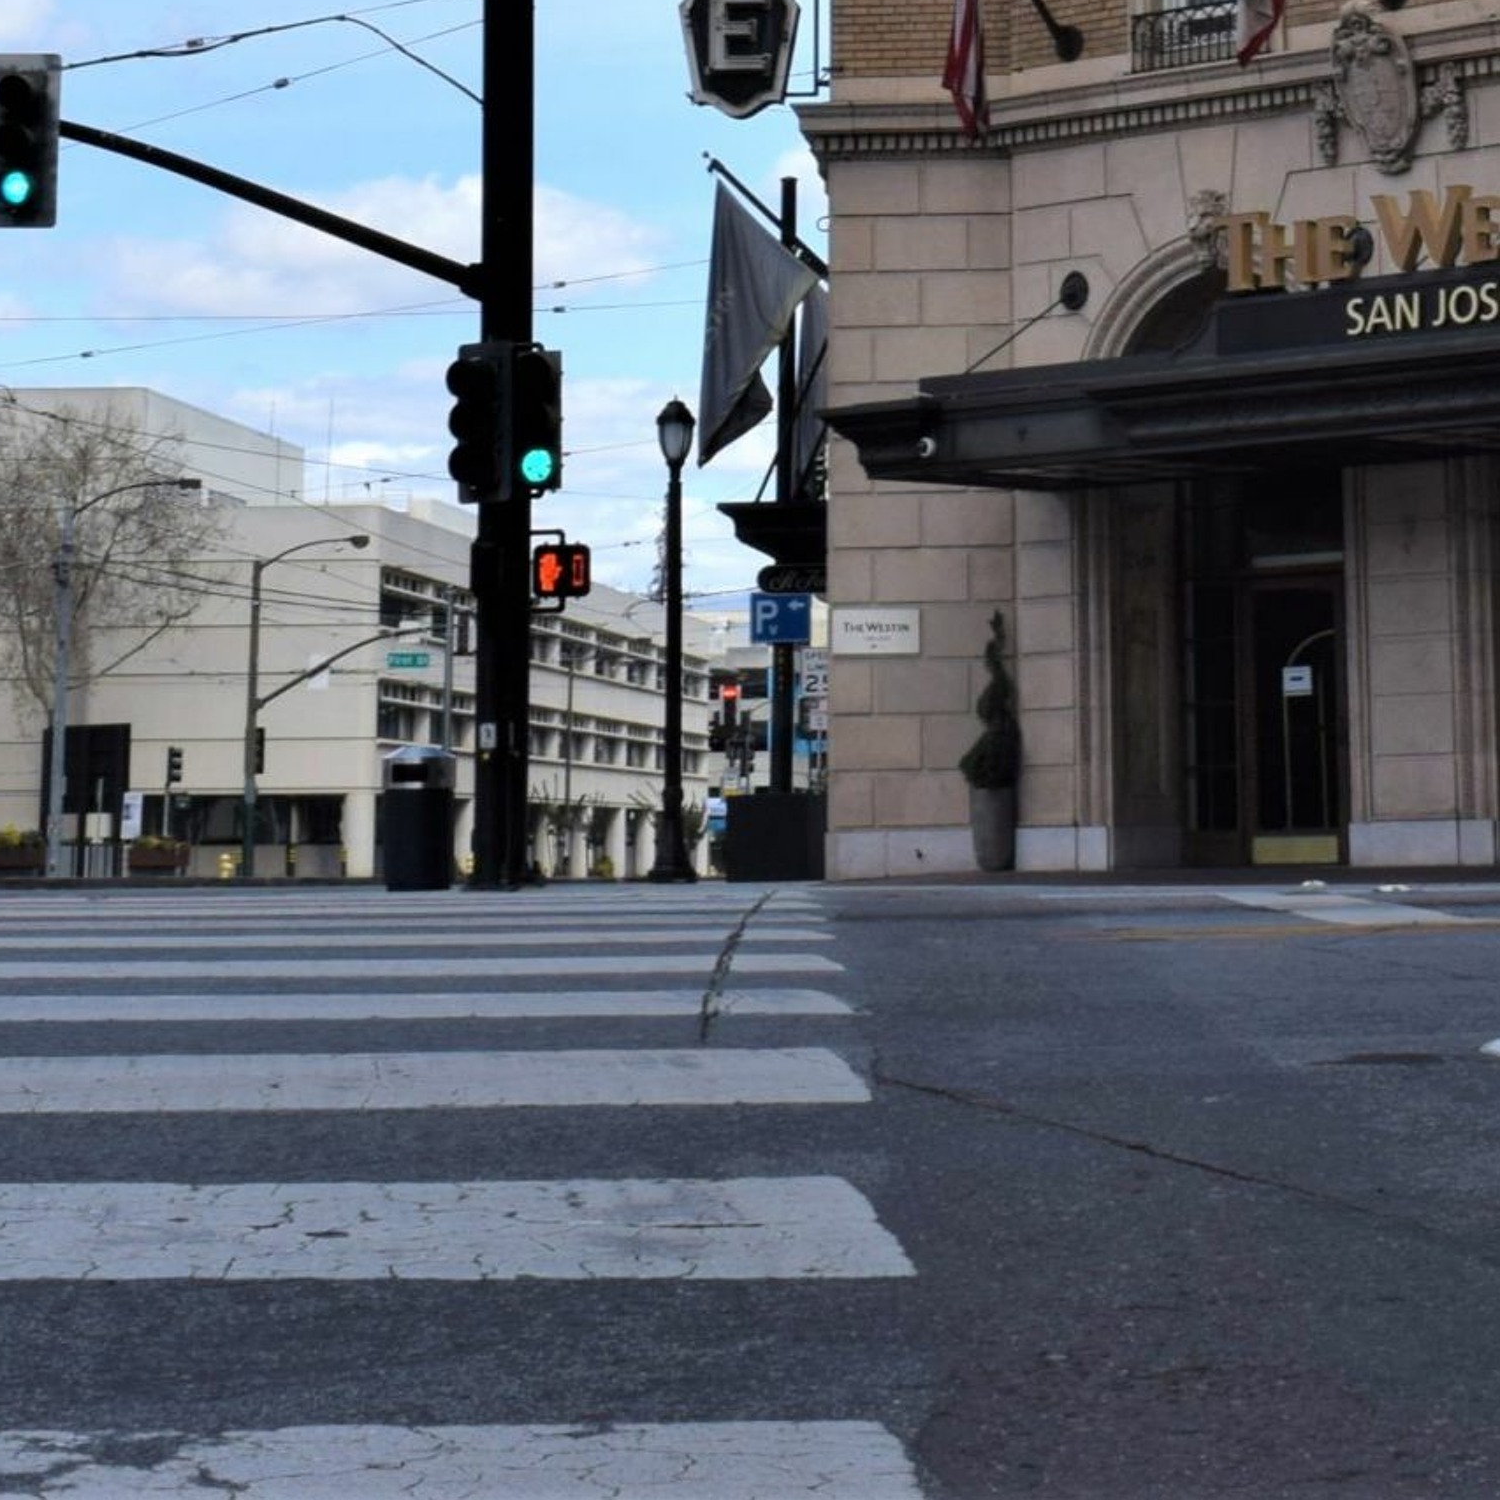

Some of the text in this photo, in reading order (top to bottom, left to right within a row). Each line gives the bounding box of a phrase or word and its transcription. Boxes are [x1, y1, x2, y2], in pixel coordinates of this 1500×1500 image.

[1213, 211, 1360, 291] THE
[1346, 282, 1499, 335] SAN JOS
[756, 601, 779, 635] P
